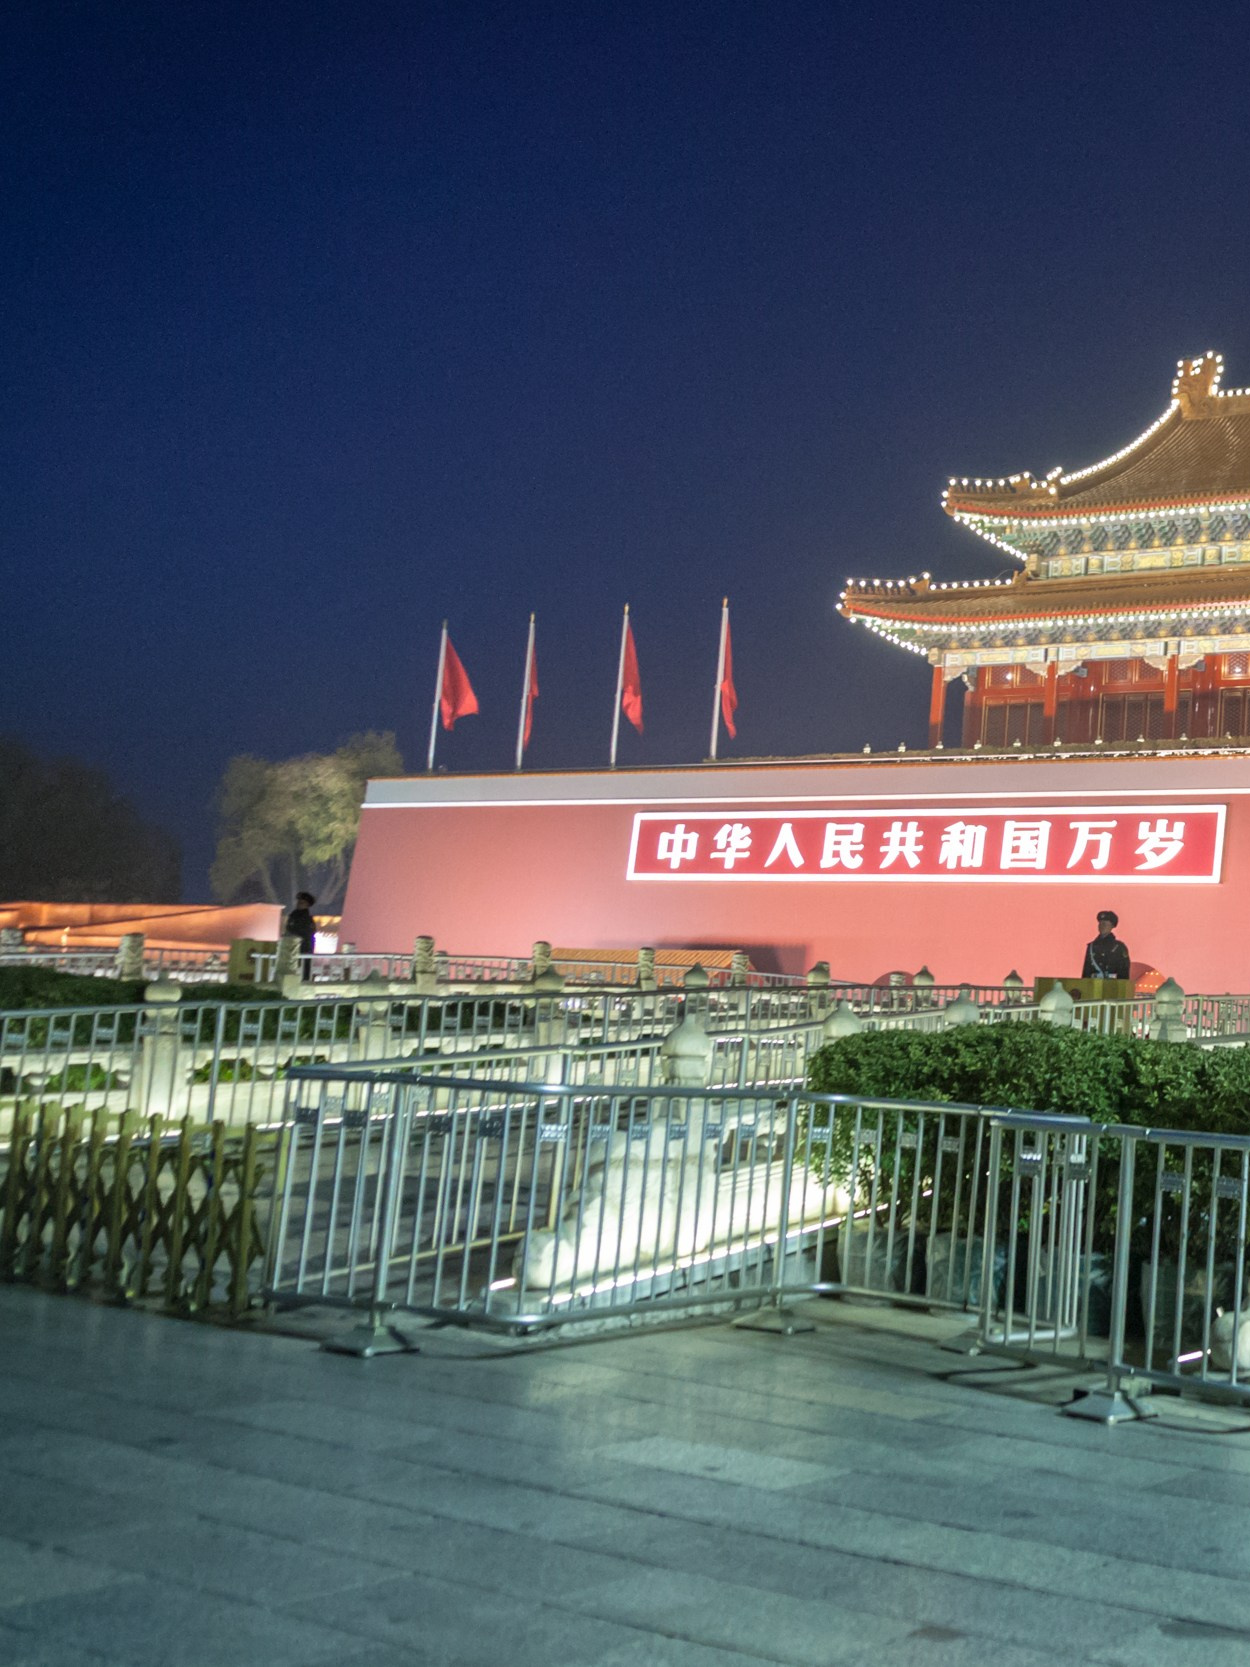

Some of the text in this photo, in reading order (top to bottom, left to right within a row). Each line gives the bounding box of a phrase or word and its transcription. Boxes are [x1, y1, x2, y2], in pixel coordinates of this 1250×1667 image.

[656, 818, 1187, 871] 中华人民共和国万岁
